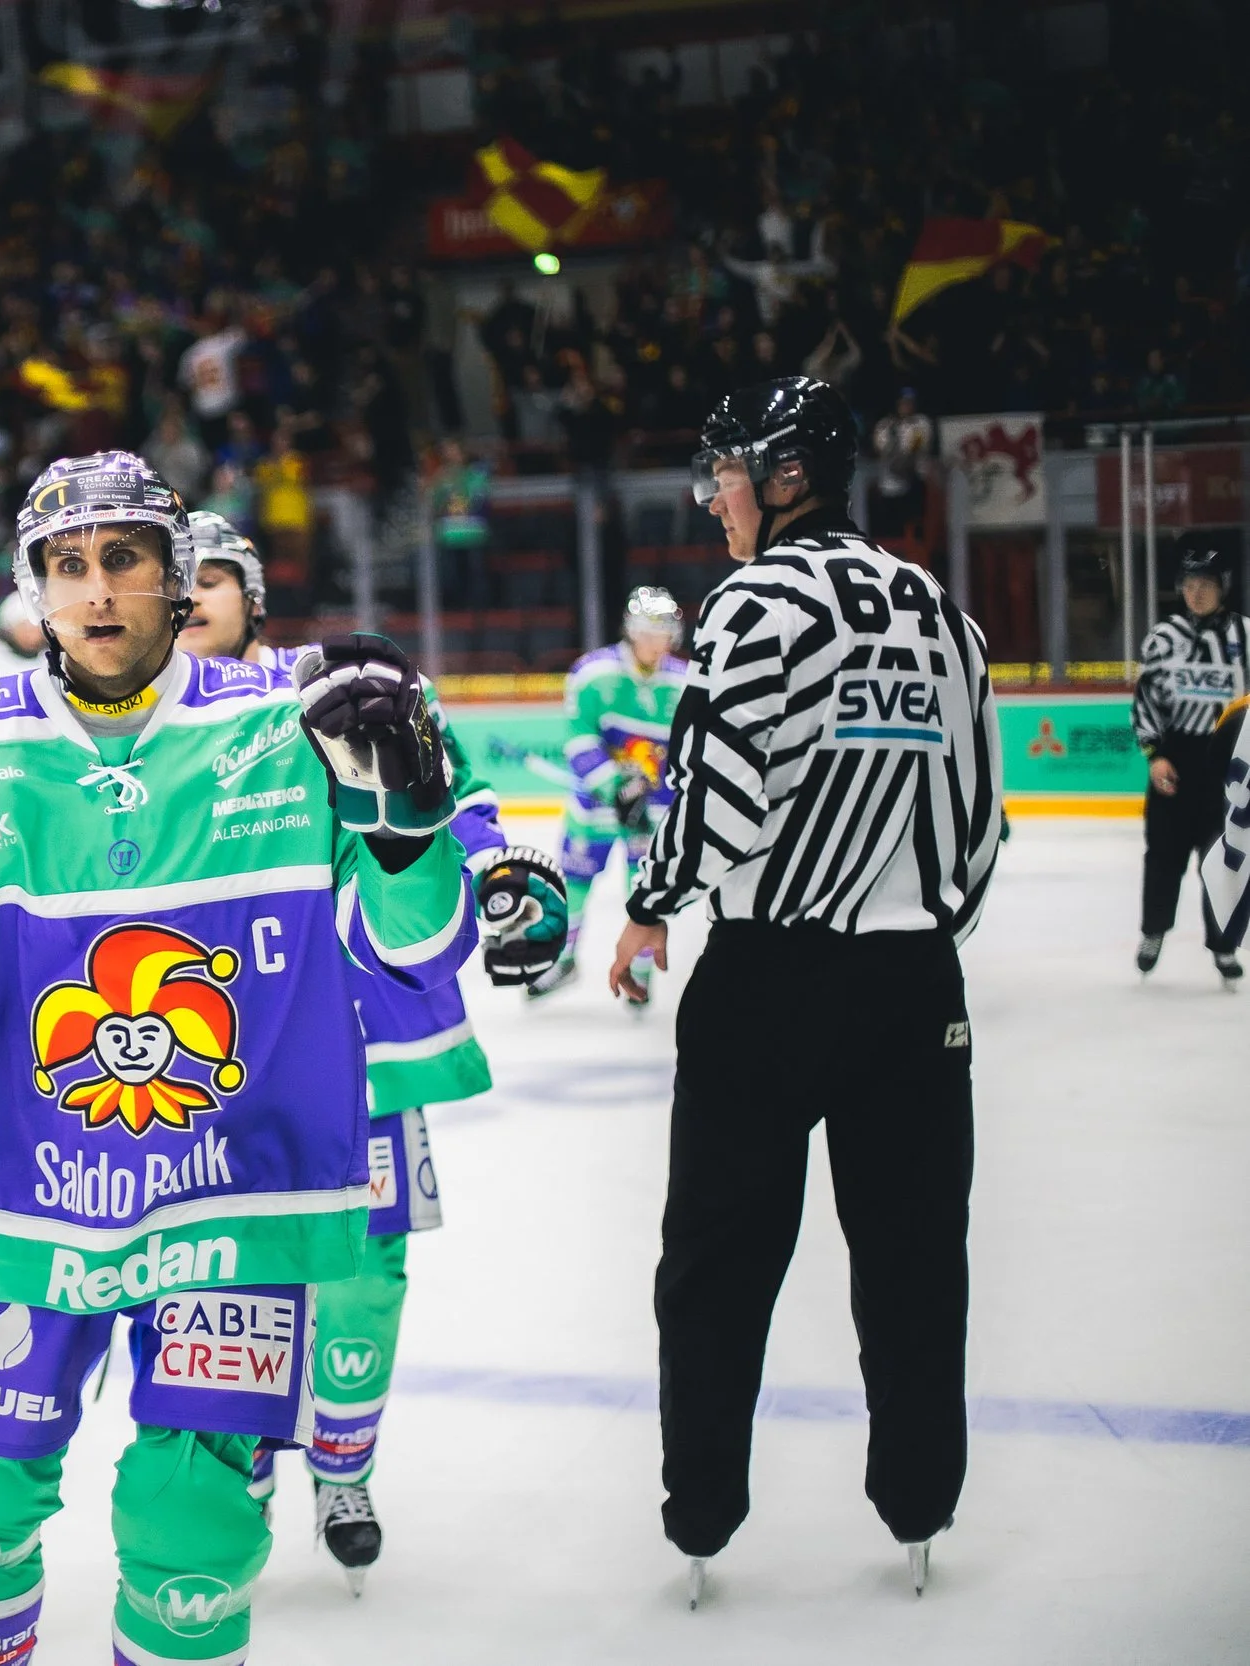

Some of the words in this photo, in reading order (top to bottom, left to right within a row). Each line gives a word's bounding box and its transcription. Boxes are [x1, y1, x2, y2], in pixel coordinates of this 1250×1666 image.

[77, 474, 136, 485] CREATIVE
[78, 481, 137, 490] TECHNOLOGY
[72, 510, 119, 522] GLASSDRIVE
[824, 558, 940, 640] 64
[837, 680, 944, 727] SVEA
[212, 814, 311, 843] ALEXANDRIA
[252, 917, 285, 974] C
[35, 1141, 135, 1219] Saldo
[45, 1233, 238, 1310] Redan
[156, 1301, 293, 1344] CABLE
[160, 1342, 286, 1386] CREW
